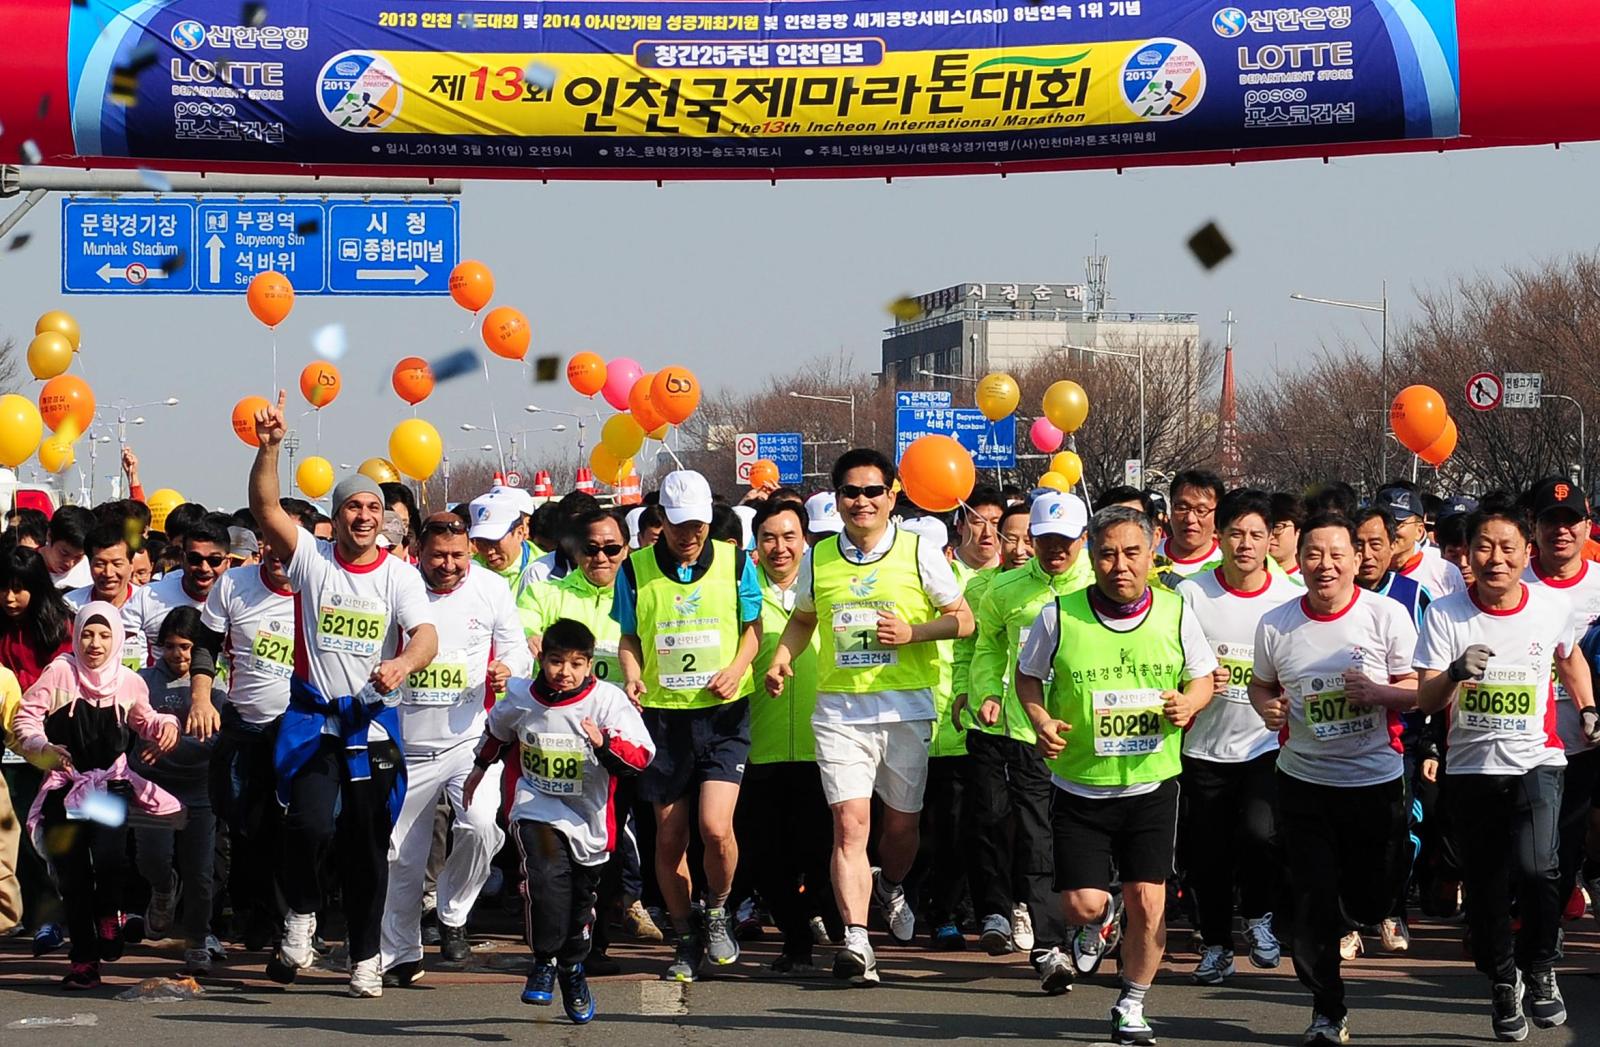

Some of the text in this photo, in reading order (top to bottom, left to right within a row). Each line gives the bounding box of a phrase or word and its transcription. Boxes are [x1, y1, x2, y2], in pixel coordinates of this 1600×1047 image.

[378, 13, 417, 27] 2013
[421, 13, 452, 29] 인천
[523, 14, 538, 29] 및
[543, 14, 581, 28] 2014
[585, 14, 662, 30] 아시안게임
[666, 15, 759, 31] 성공개최기원
[764, 15, 778, 30] 및
[784, 14, 849, 29] 인천공항
[1014, 5, 1072, 22] 8년연속
[1078, 4, 1103, 19] 1위
[1109, 1, 1141, 17] 기념
[1248, 6, 1352, 33] 신한은행
[207, 26, 309, 50] 신한은행
[655, 43, 864, 66] 창간25주년 인천일보
[1238, 42, 1353, 71] LOTTE
[171, 58, 284, 86] LOTTE
[1125, 70, 1154, 81] 2013
[1239, 69, 1354, 85] DEPARTMENT STORE
[248, 89, 284, 100] STORE
[323, 81, 351, 91] 2013
[564, 52, 1092, 134] 인천국제마라톤대회
[1244, 88, 1307, 108] posco
[174, 102, 236, 119] posco
[1244, 103, 1354, 127] 포스코건설
[175, 119, 285, 144] 포스코건설
[807, 120, 877, 133] Incheon
[882, 115, 999, 131] International
[1003, 112, 1086, 127] Marathon
[81, 213, 178, 237] 문학경기장
[235, 211, 295, 232] 부평역
[83, 241, 178, 256] Munhak Stadium
[235, 232, 305, 248] Bupyeong Stn
[363, 238, 443, 263] 종합터미널
[235, 251, 296, 272] 석바위
[321, 613, 379, 639] 52195
[321, 636, 375, 654] 포스코건설
[858, 631, 868, 650] 1
[681, 653, 697, 672] 2
[841, 653, 891, 665] 포스코건설
[409, 669, 463, 689] 52194
[1072, 663, 1174, 684] 인천경영자총협회
[411, 691, 460, 703] 포스코건설
[1465, 689, 1531, 715] 50639
[1100, 713, 1160, 737] 50284
[1315, 718, 1374, 738] 포스코건설
[1467, 714, 1527, 731] 포스코건설
[1104, 738, 1158, 753] 포스코건설
[523, 750, 578, 779] 52198
